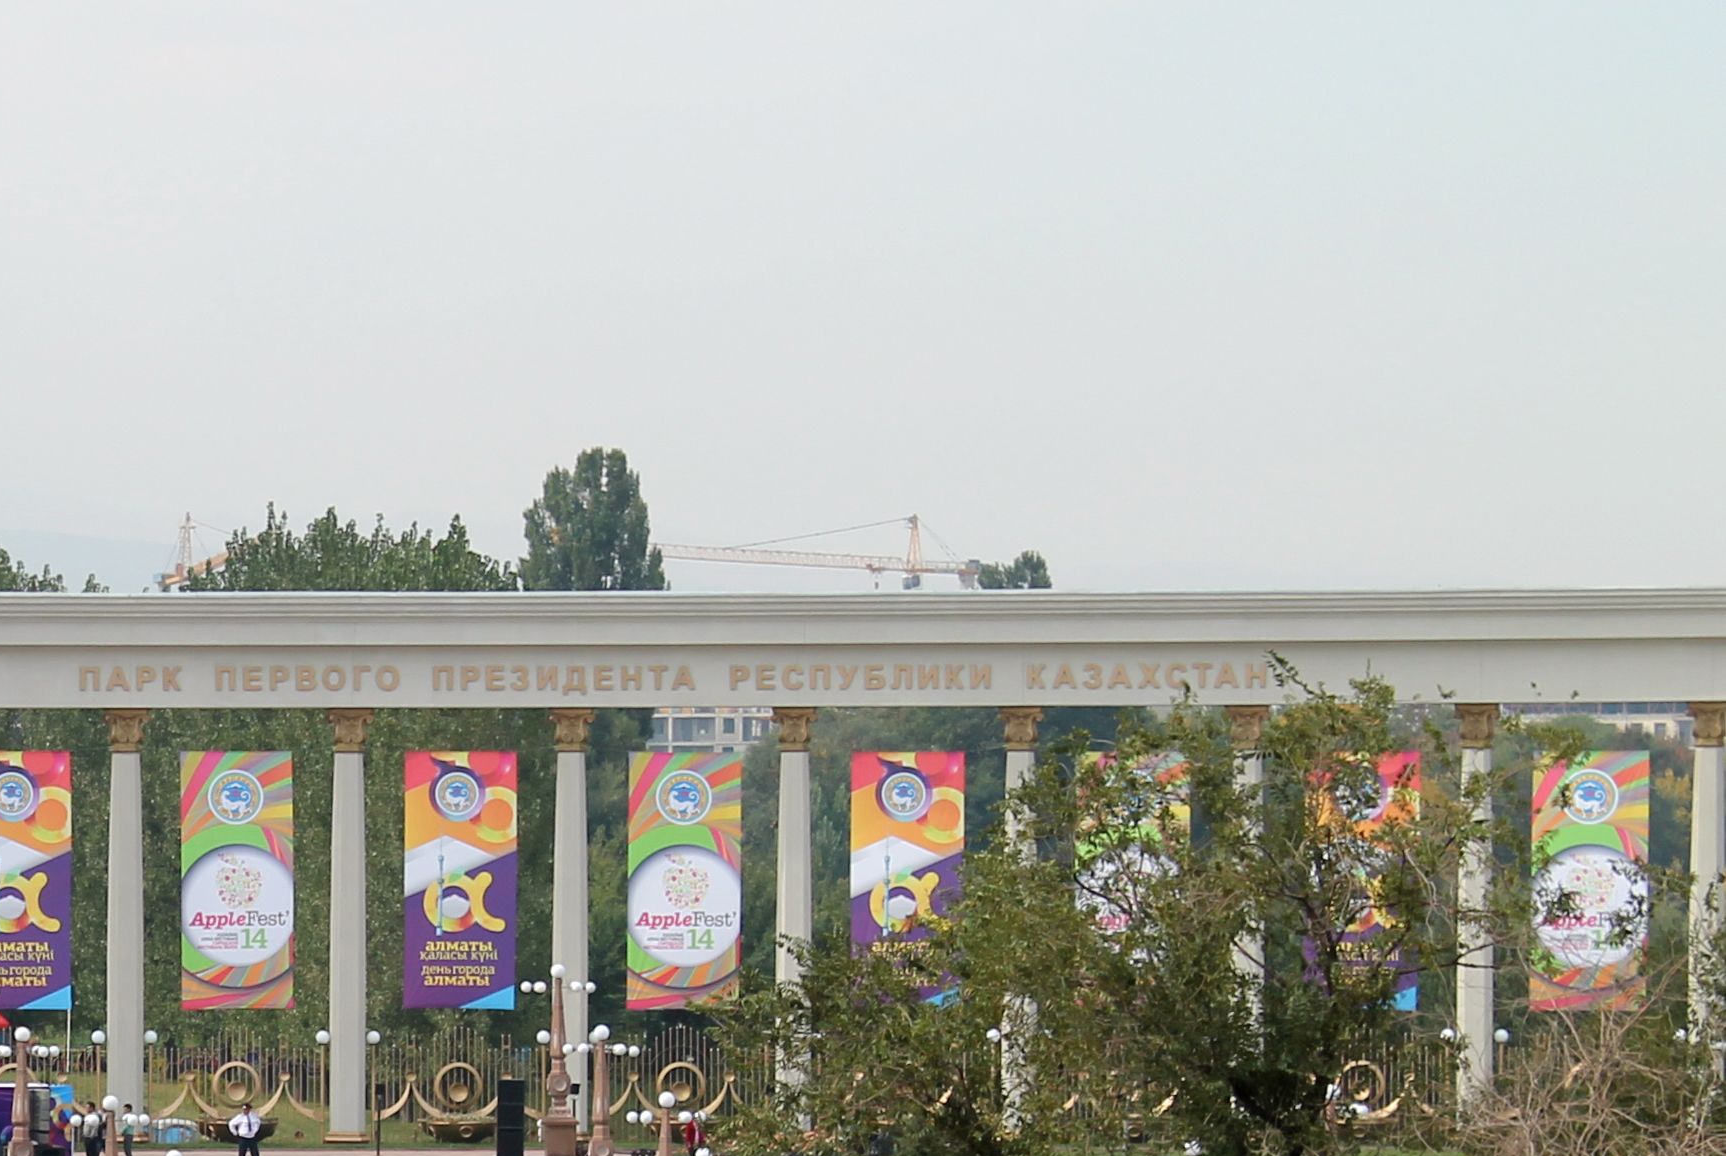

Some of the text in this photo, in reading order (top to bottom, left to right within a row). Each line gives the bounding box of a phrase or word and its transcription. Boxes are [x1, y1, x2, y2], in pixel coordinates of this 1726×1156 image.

[78, 662, 1269, 695] ПАРК ПЕРВОГО ПРЕЗИДЕНТА РЕСПУБЛИКИ КАЗАХСТАН
[240, 928, 268, 949] 14
[687, 928, 714, 950] 14
[425, 941, 492, 951] алматы
[9, 966, 52, 978] города
[421, 965, 495, 978] день города
[424, 975, 490, 986] алматы
